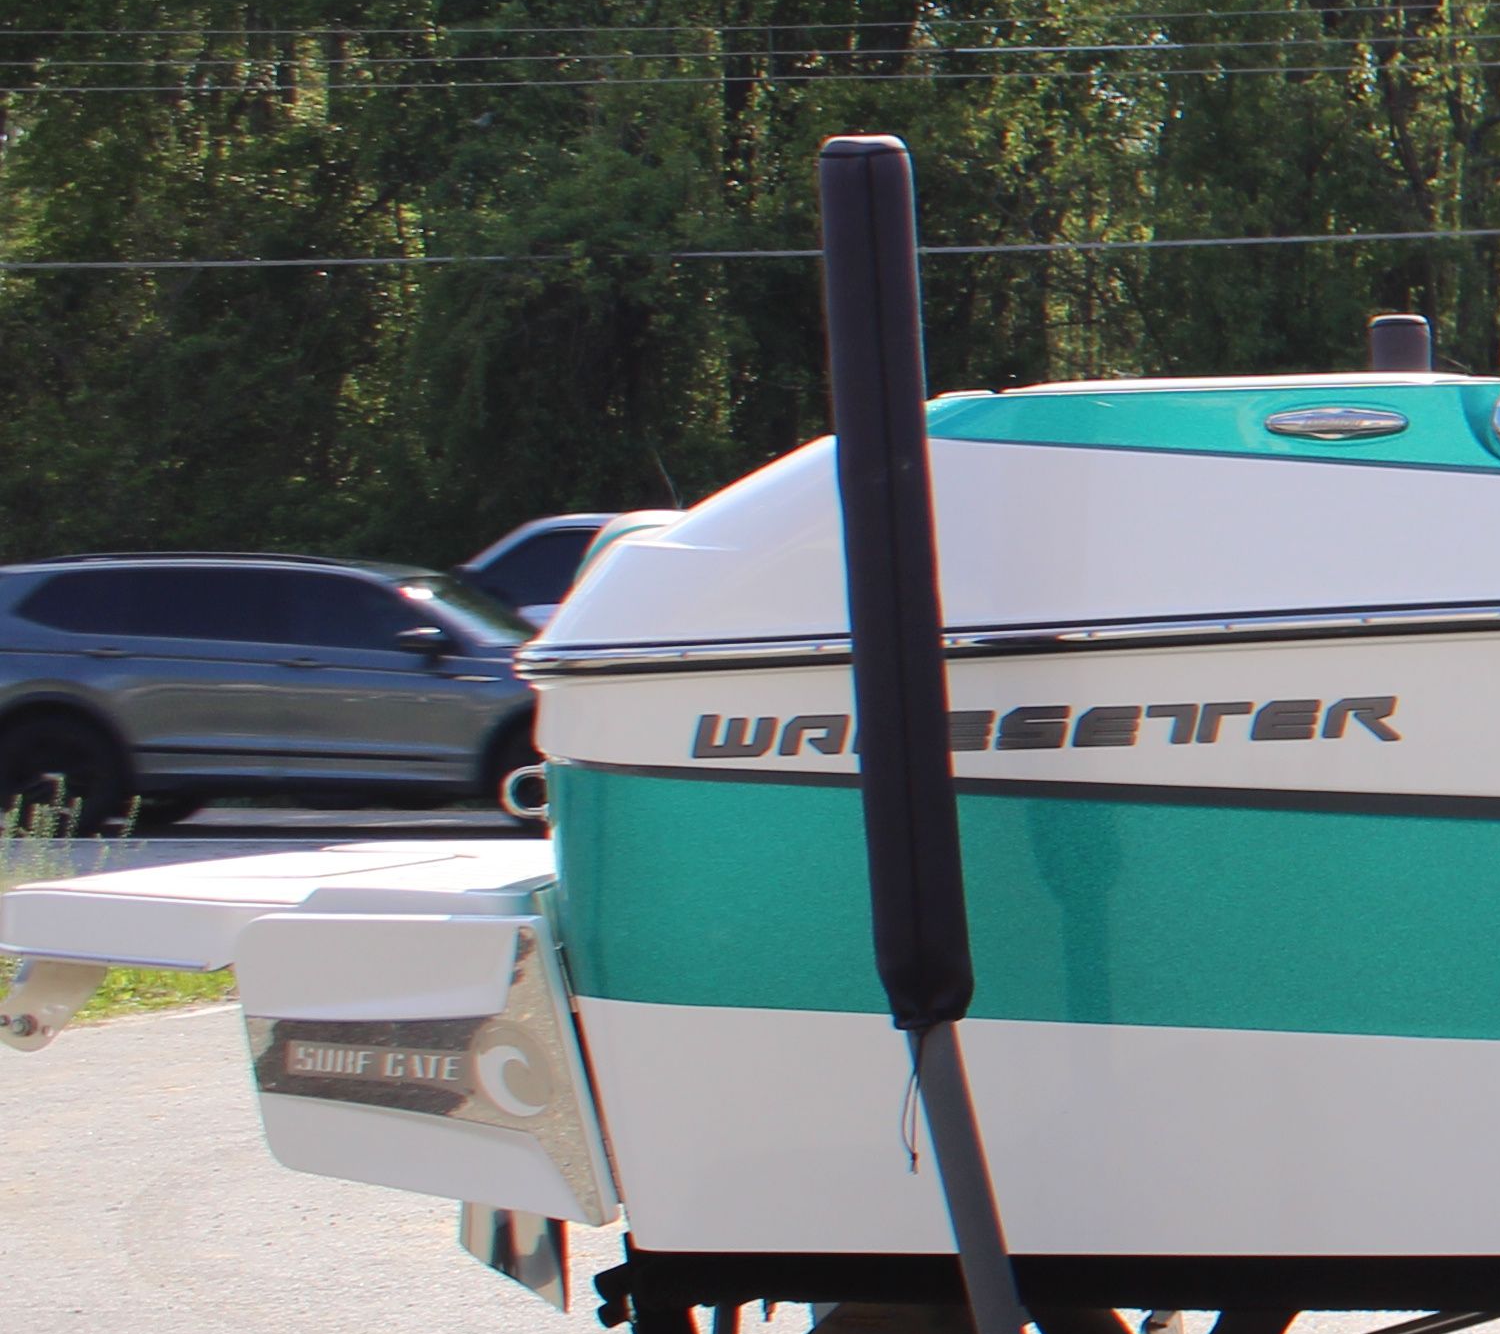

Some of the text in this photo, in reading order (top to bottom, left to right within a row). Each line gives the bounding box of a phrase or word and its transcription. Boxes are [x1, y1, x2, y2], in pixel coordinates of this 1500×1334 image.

[691, 696, 1403, 758] WAESETTER
[297, 1046, 463, 1081] SURF GATE
